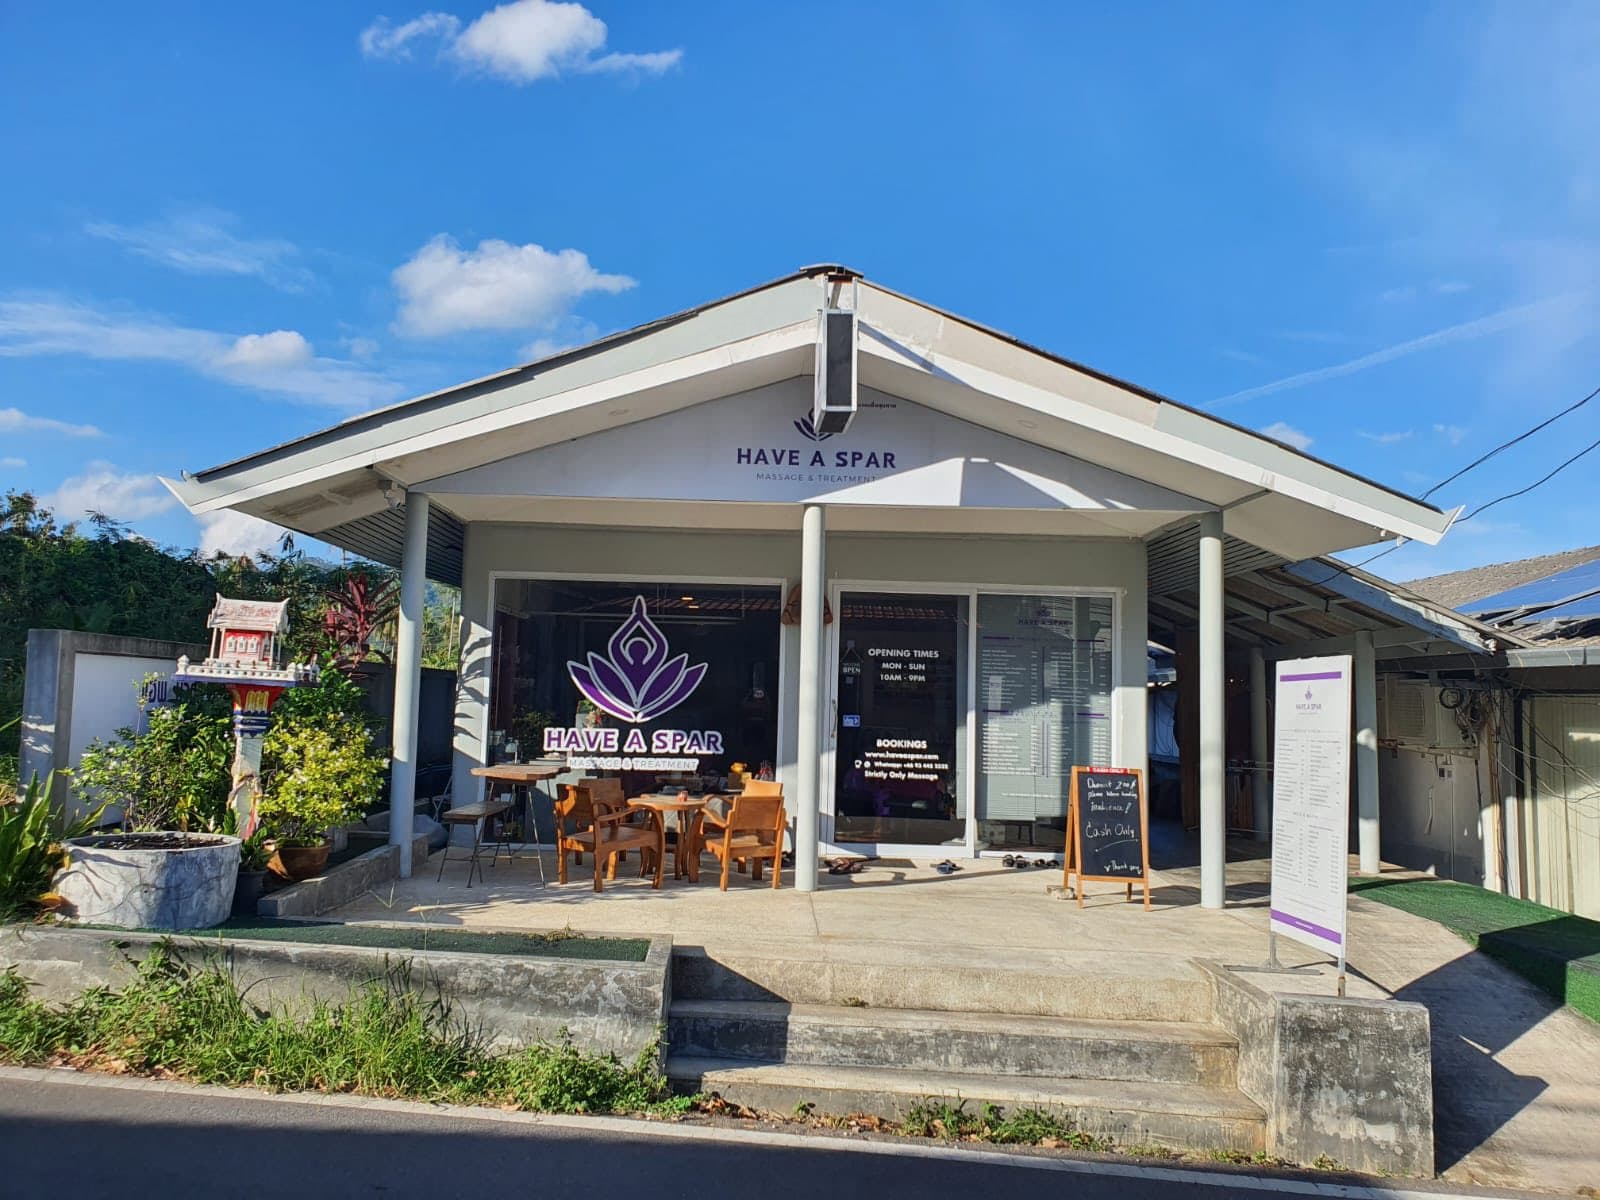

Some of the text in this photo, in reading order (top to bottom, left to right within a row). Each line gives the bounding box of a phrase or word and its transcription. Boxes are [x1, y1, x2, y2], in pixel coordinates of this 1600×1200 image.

[736, 448, 896, 468] HAVE A SPAR
[756, 472, 803, 482] MASSAGE
[817, 474, 876, 484] TREATMENT
[868, 648, 940, 658] OPENING TIMES
[908, 663, 926, 671] SUN
[880, 674, 902, 682] 10AM
[908, 674, 926, 682] 9PM
[544, 728, 722, 753] HAVE A SPAR
[876, 739, 928, 749] BOOKINGS
[622, 758, 632, 769] &
[634, 759, 698, 770] TREATMENT
[864, 770, 888, 780] Strictly
[890, 771, 906, 780] Only
[1086, 821, 1135, 838] Cash Only
[1110, 860, 1128, 871] Thank
